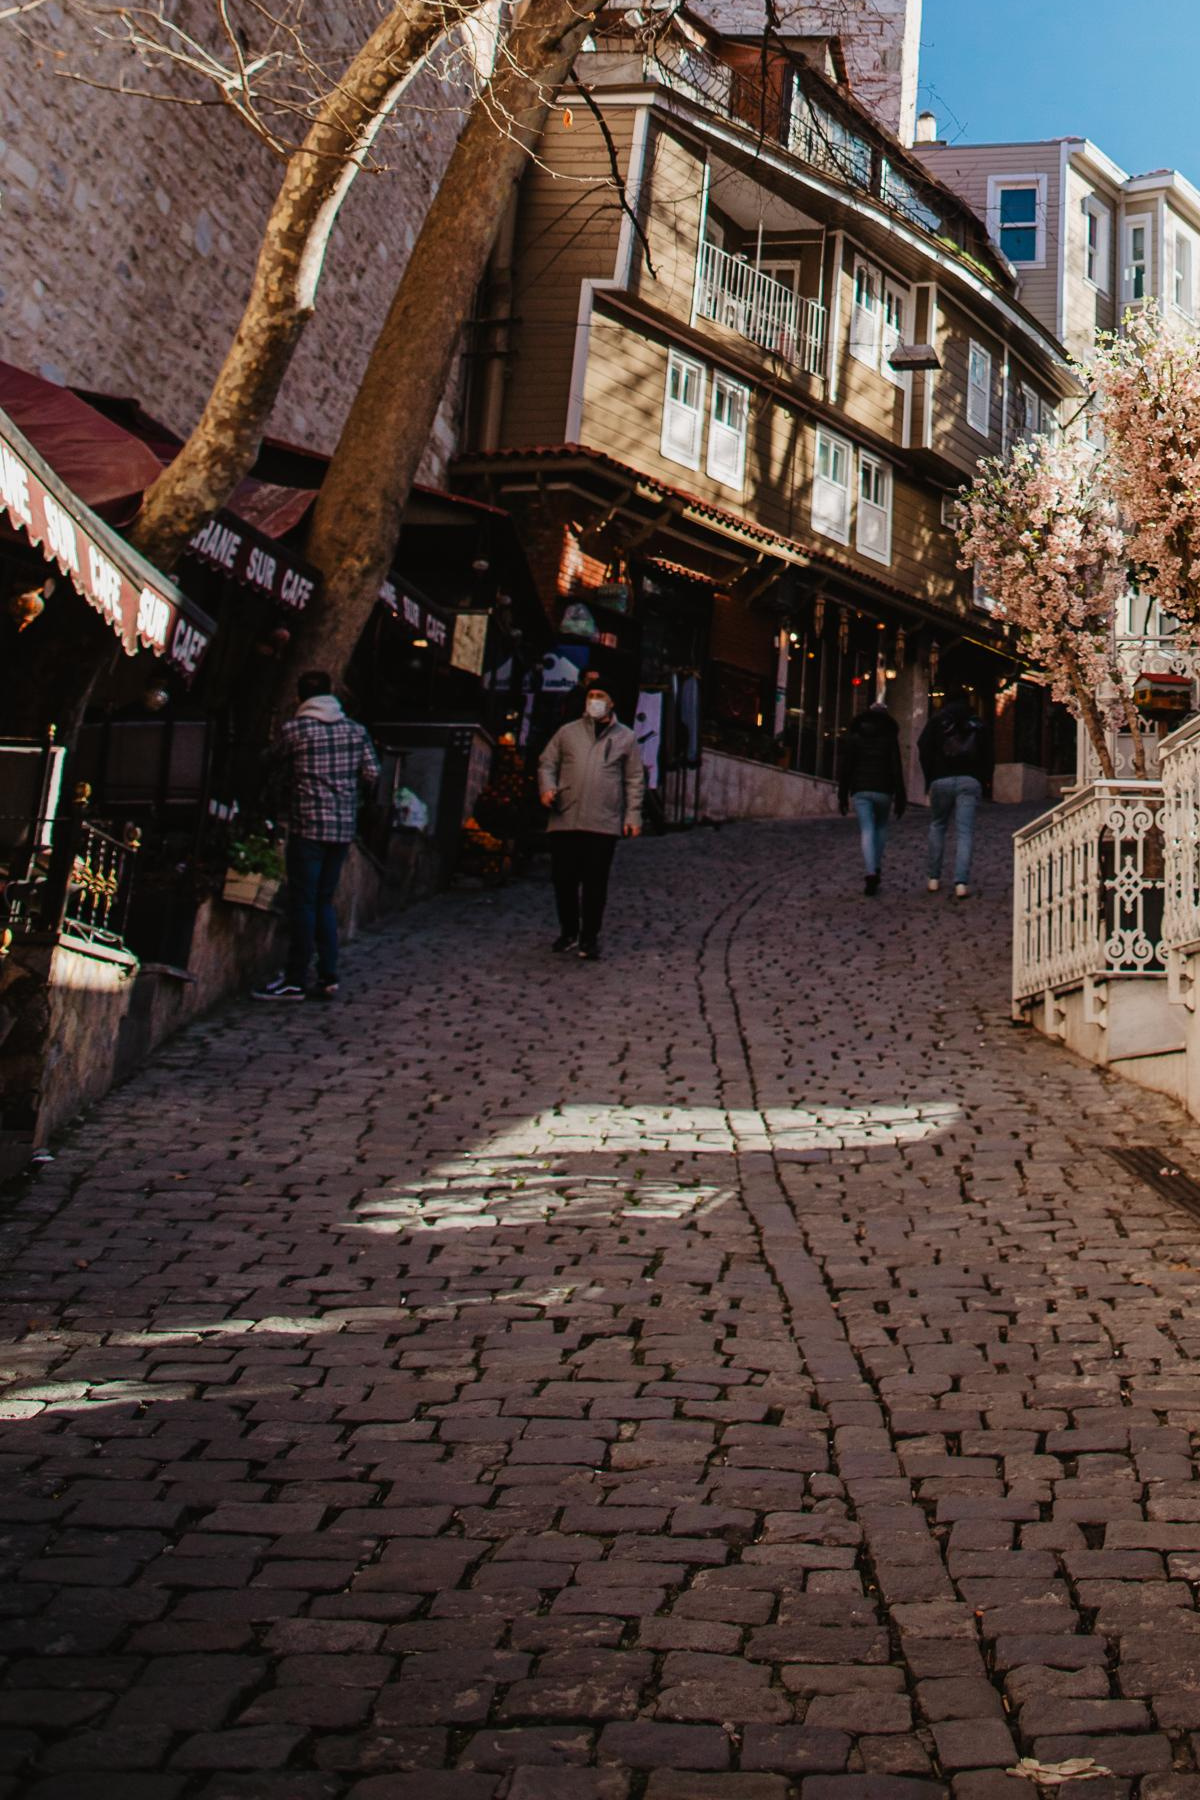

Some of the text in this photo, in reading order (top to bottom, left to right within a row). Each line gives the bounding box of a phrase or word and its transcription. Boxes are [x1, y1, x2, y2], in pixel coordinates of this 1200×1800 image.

[43, 495, 79, 573] SUR
[190, 520, 242, 569] HANE
[246, 547, 276, 590] SUR
[137, 587, 170, 646] SUR
